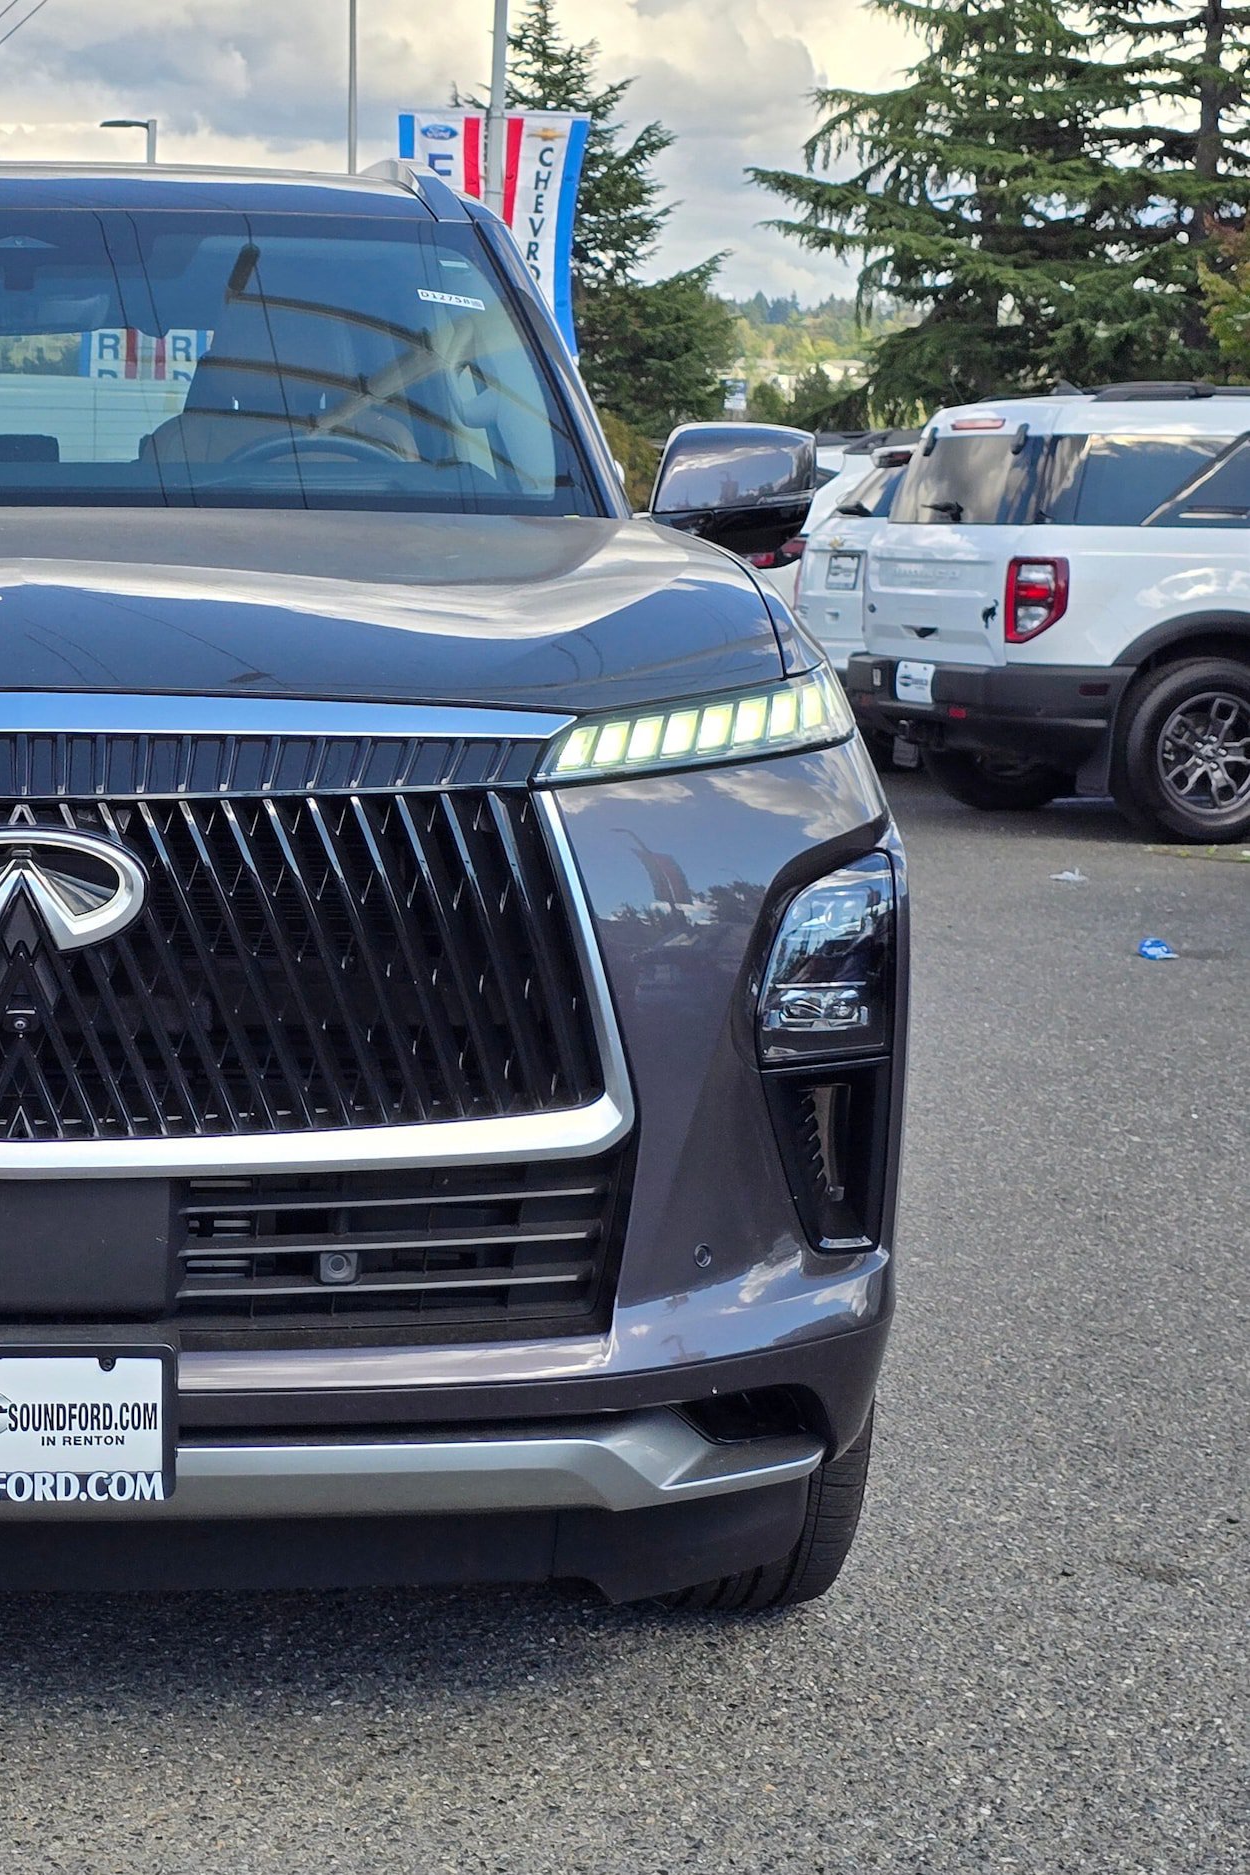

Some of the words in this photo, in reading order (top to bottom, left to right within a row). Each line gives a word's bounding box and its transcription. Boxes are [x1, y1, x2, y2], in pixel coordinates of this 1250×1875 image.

[7, 1402, 158, 1432] SOUNDFORD.COM
[41, 1435, 57, 1447] IN
[62, 1435, 126, 1447] RENTON
